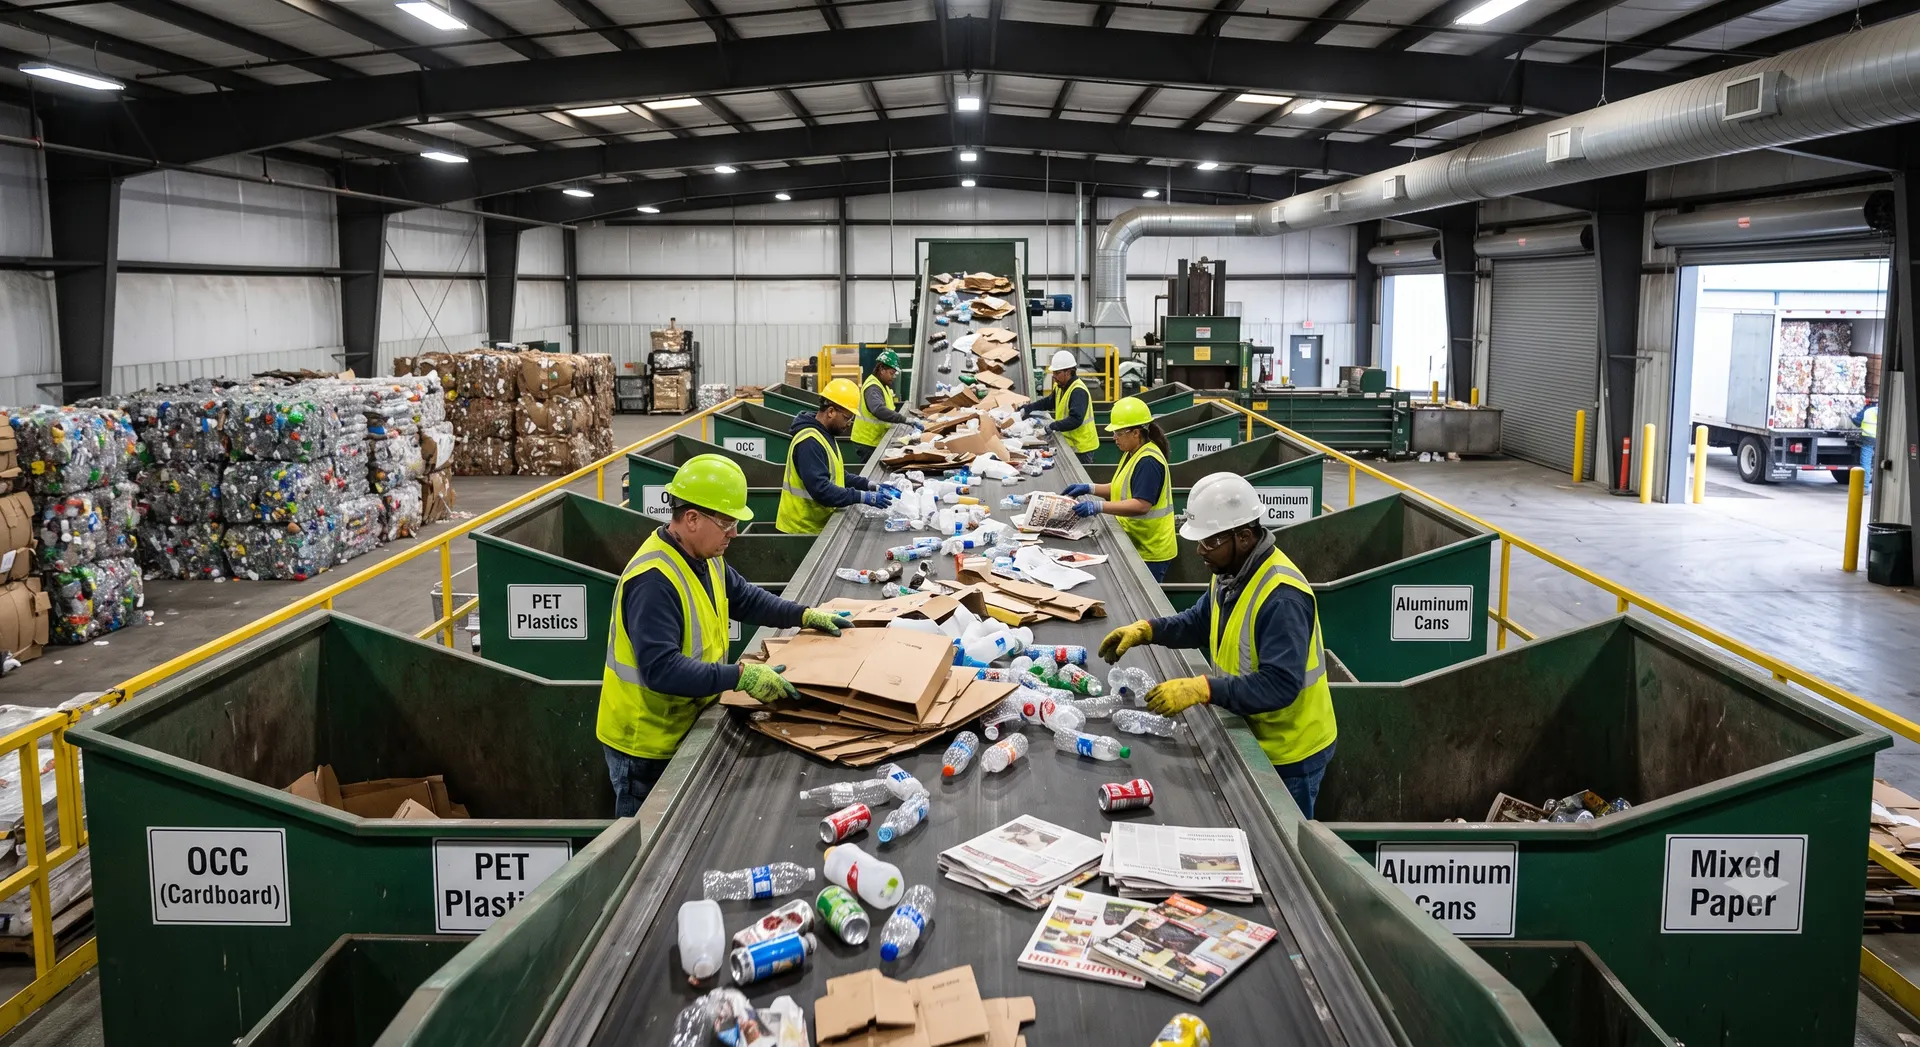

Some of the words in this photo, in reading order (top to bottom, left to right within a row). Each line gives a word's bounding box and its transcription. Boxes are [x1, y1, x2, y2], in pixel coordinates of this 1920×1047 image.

[735, 442, 755, 452] OCC
[1197, 443, 1222, 452] Mixed
[1268, 507, 1295, 519] Cans
[532, 594, 562, 609] PET
[1396, 597, 1468, 611] Aluminum
[517, 614, 578, 630] Plastics
[1415, 615, 1449, 630] Cans
[187, 846, 248, 876] OCC
[475, 853, 530, 880] PET
[1690, 850, 1780, 878] Mixed
[1382, 859, 1511, 884] Aluminum
[160, 883, 280, 909] (Cardboard)
[1690, 888, 1777, 922] Paper
